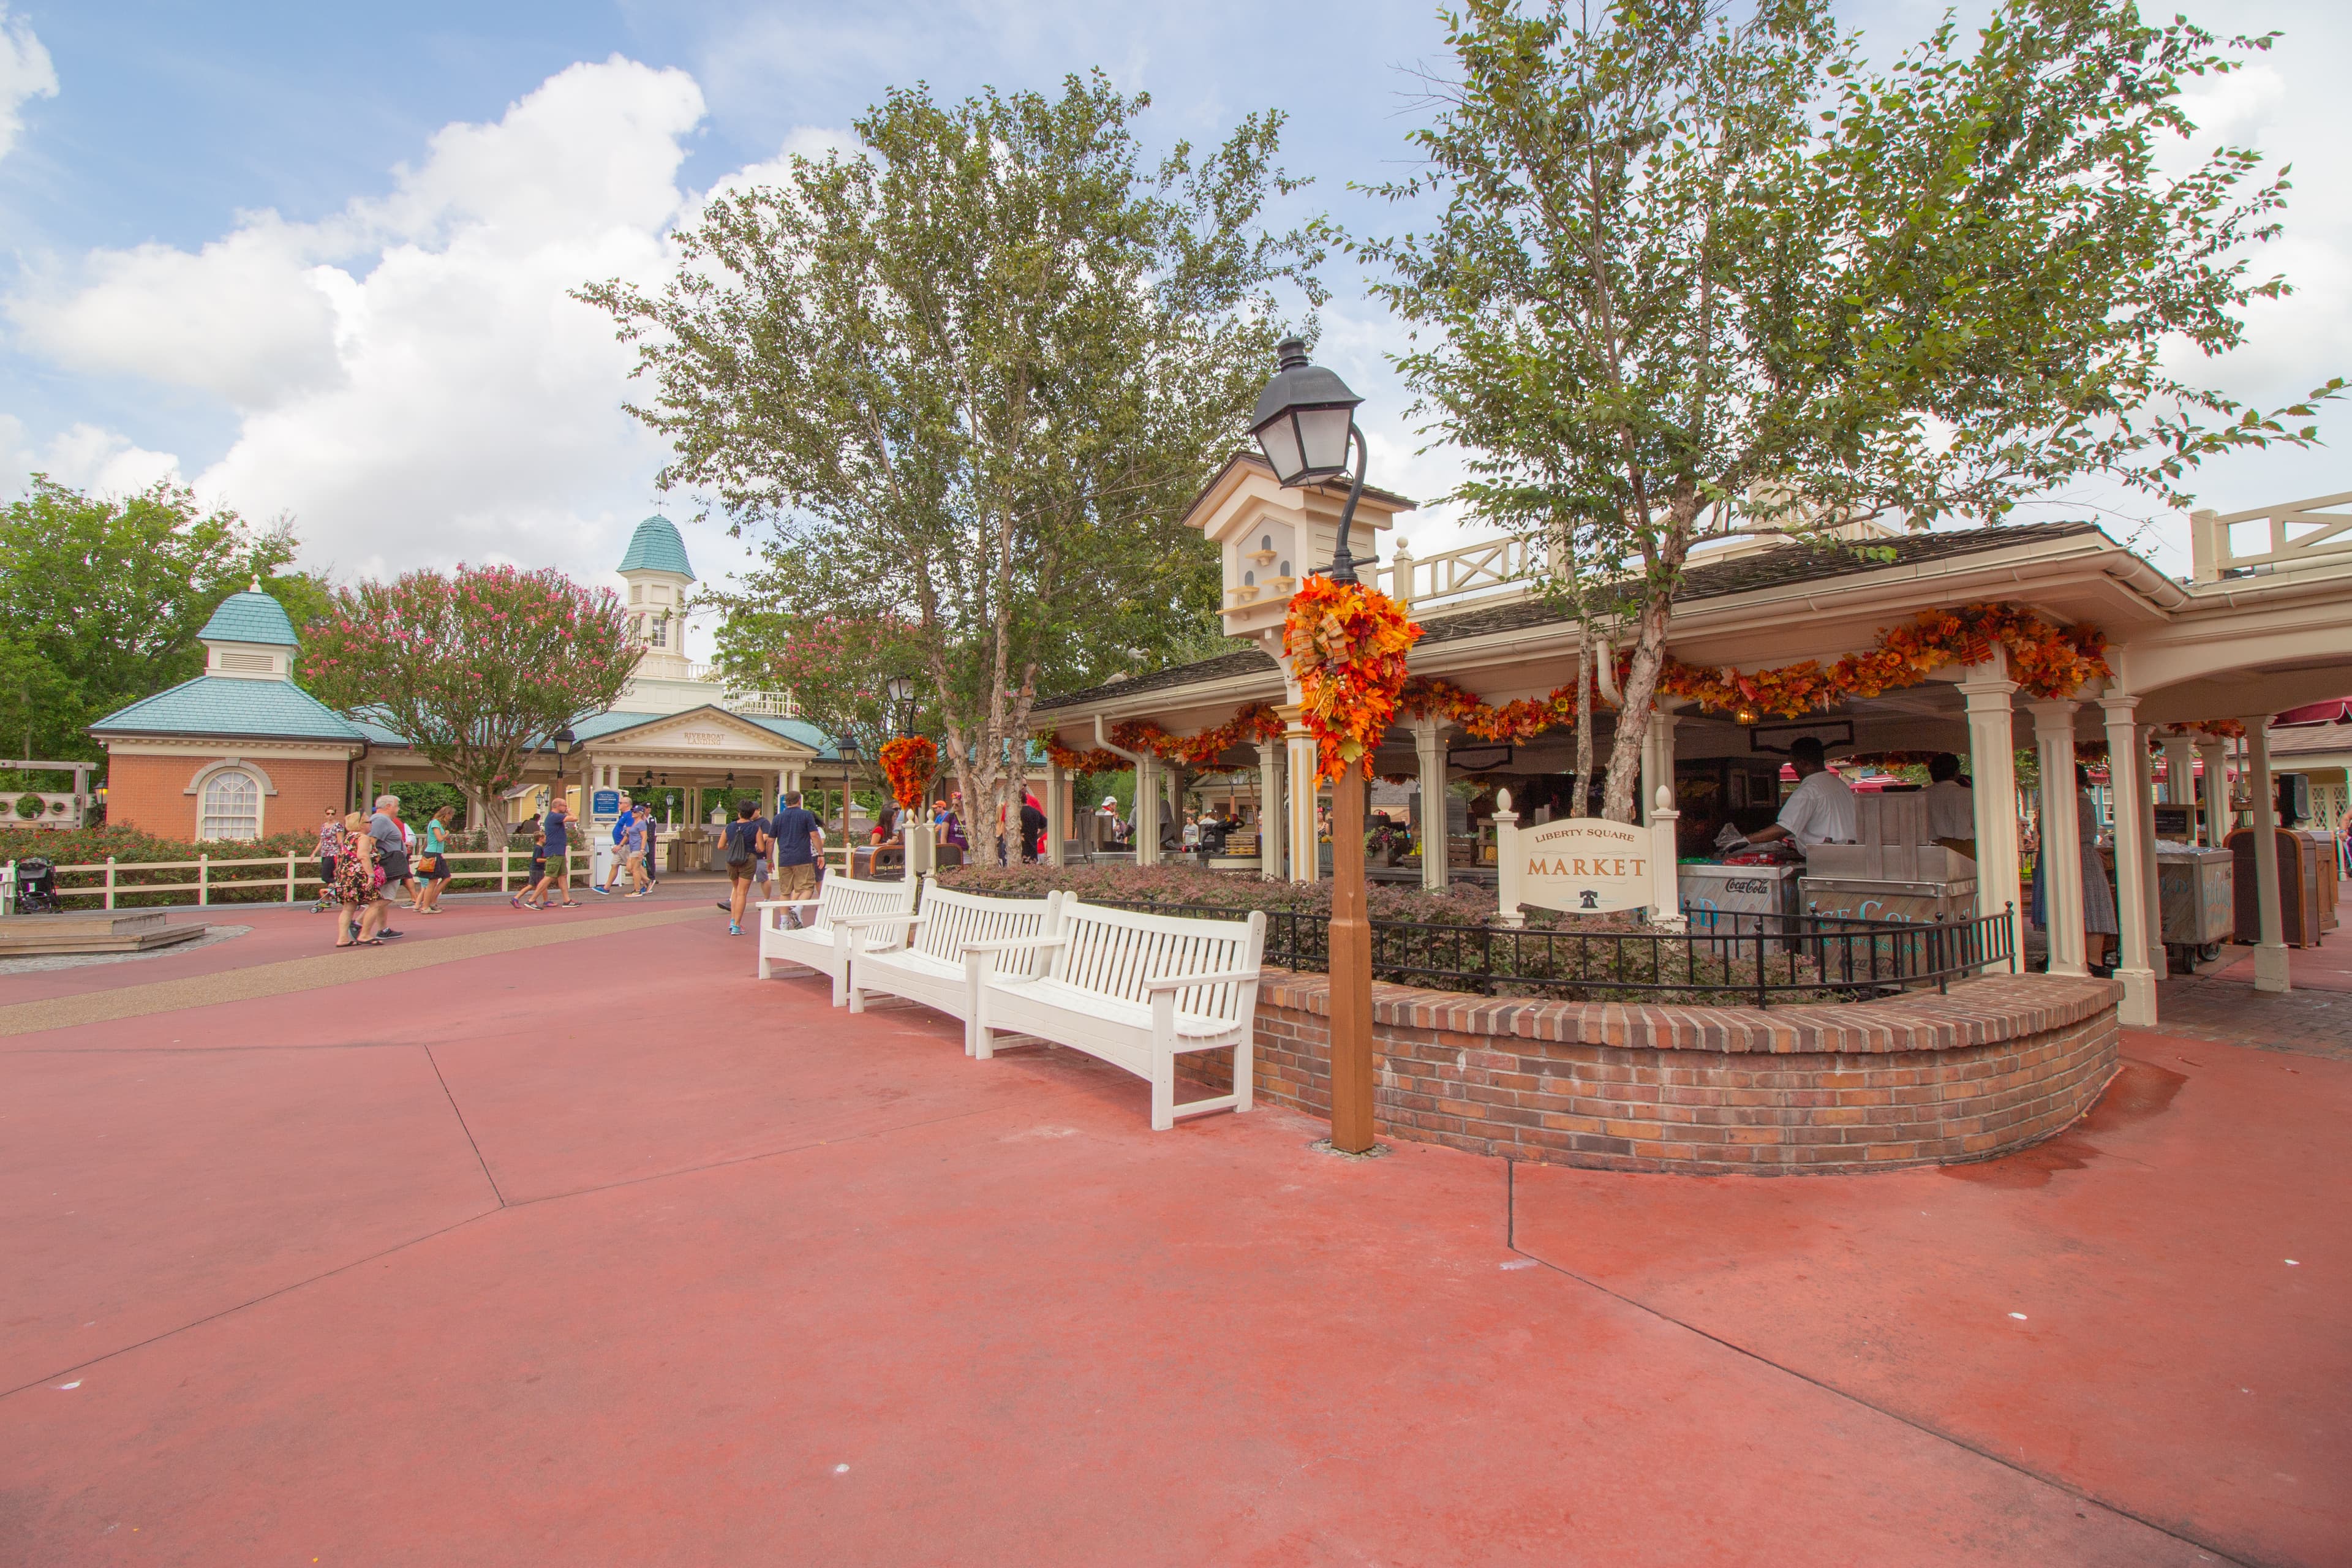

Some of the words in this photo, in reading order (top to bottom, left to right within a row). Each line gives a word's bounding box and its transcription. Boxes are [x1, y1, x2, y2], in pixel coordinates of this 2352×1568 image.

[1534, 829, 1583, 843] LIBERTY
[1587, 828, 1635, 842] SQUARE
[1527, 858, 1646, 876] MARKET
